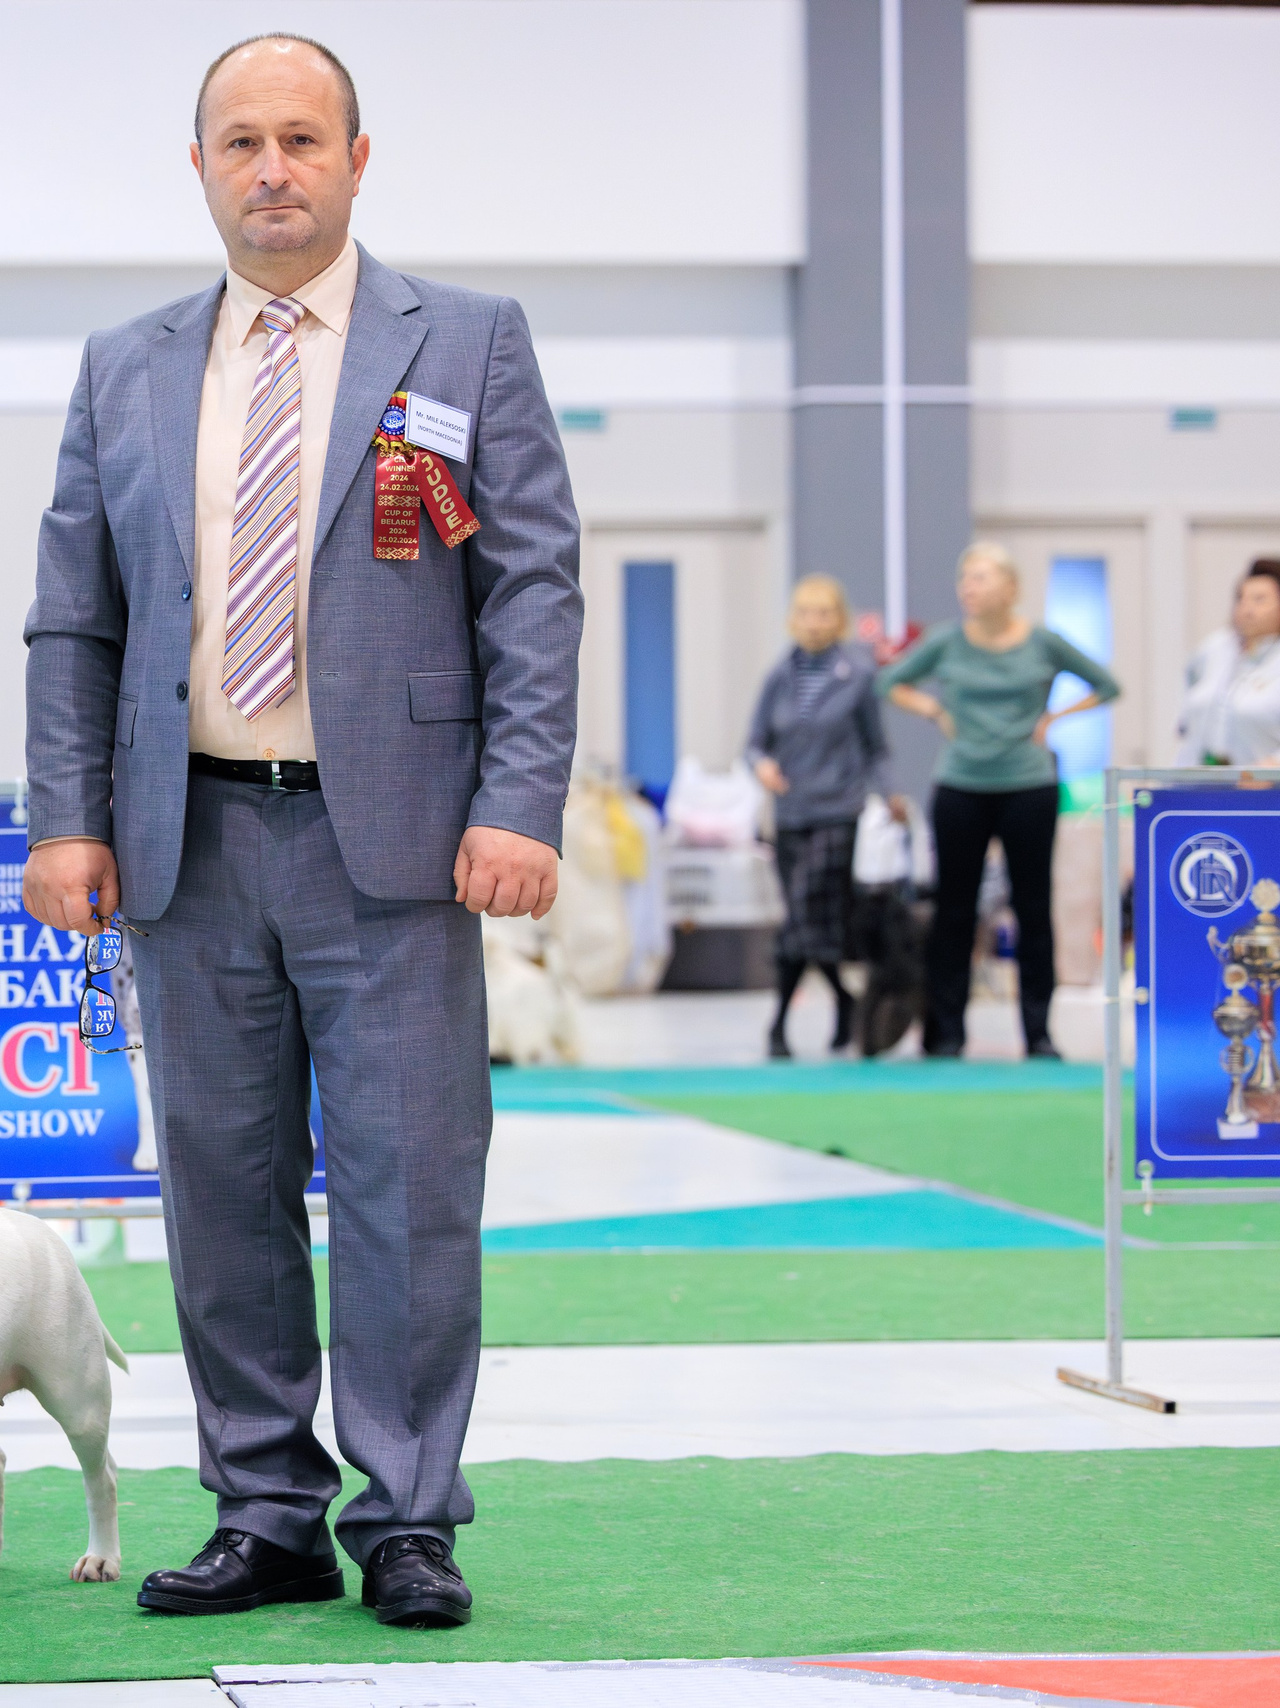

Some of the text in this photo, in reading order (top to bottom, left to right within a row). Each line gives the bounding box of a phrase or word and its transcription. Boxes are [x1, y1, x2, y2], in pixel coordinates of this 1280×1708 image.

[390, 474, 409, 482] 2024
[380, 484, 419, 492] 24.02.2024
[421, 455, 463, 530] JUDGE
[378, 536, 418, 544] 25.02.2024
